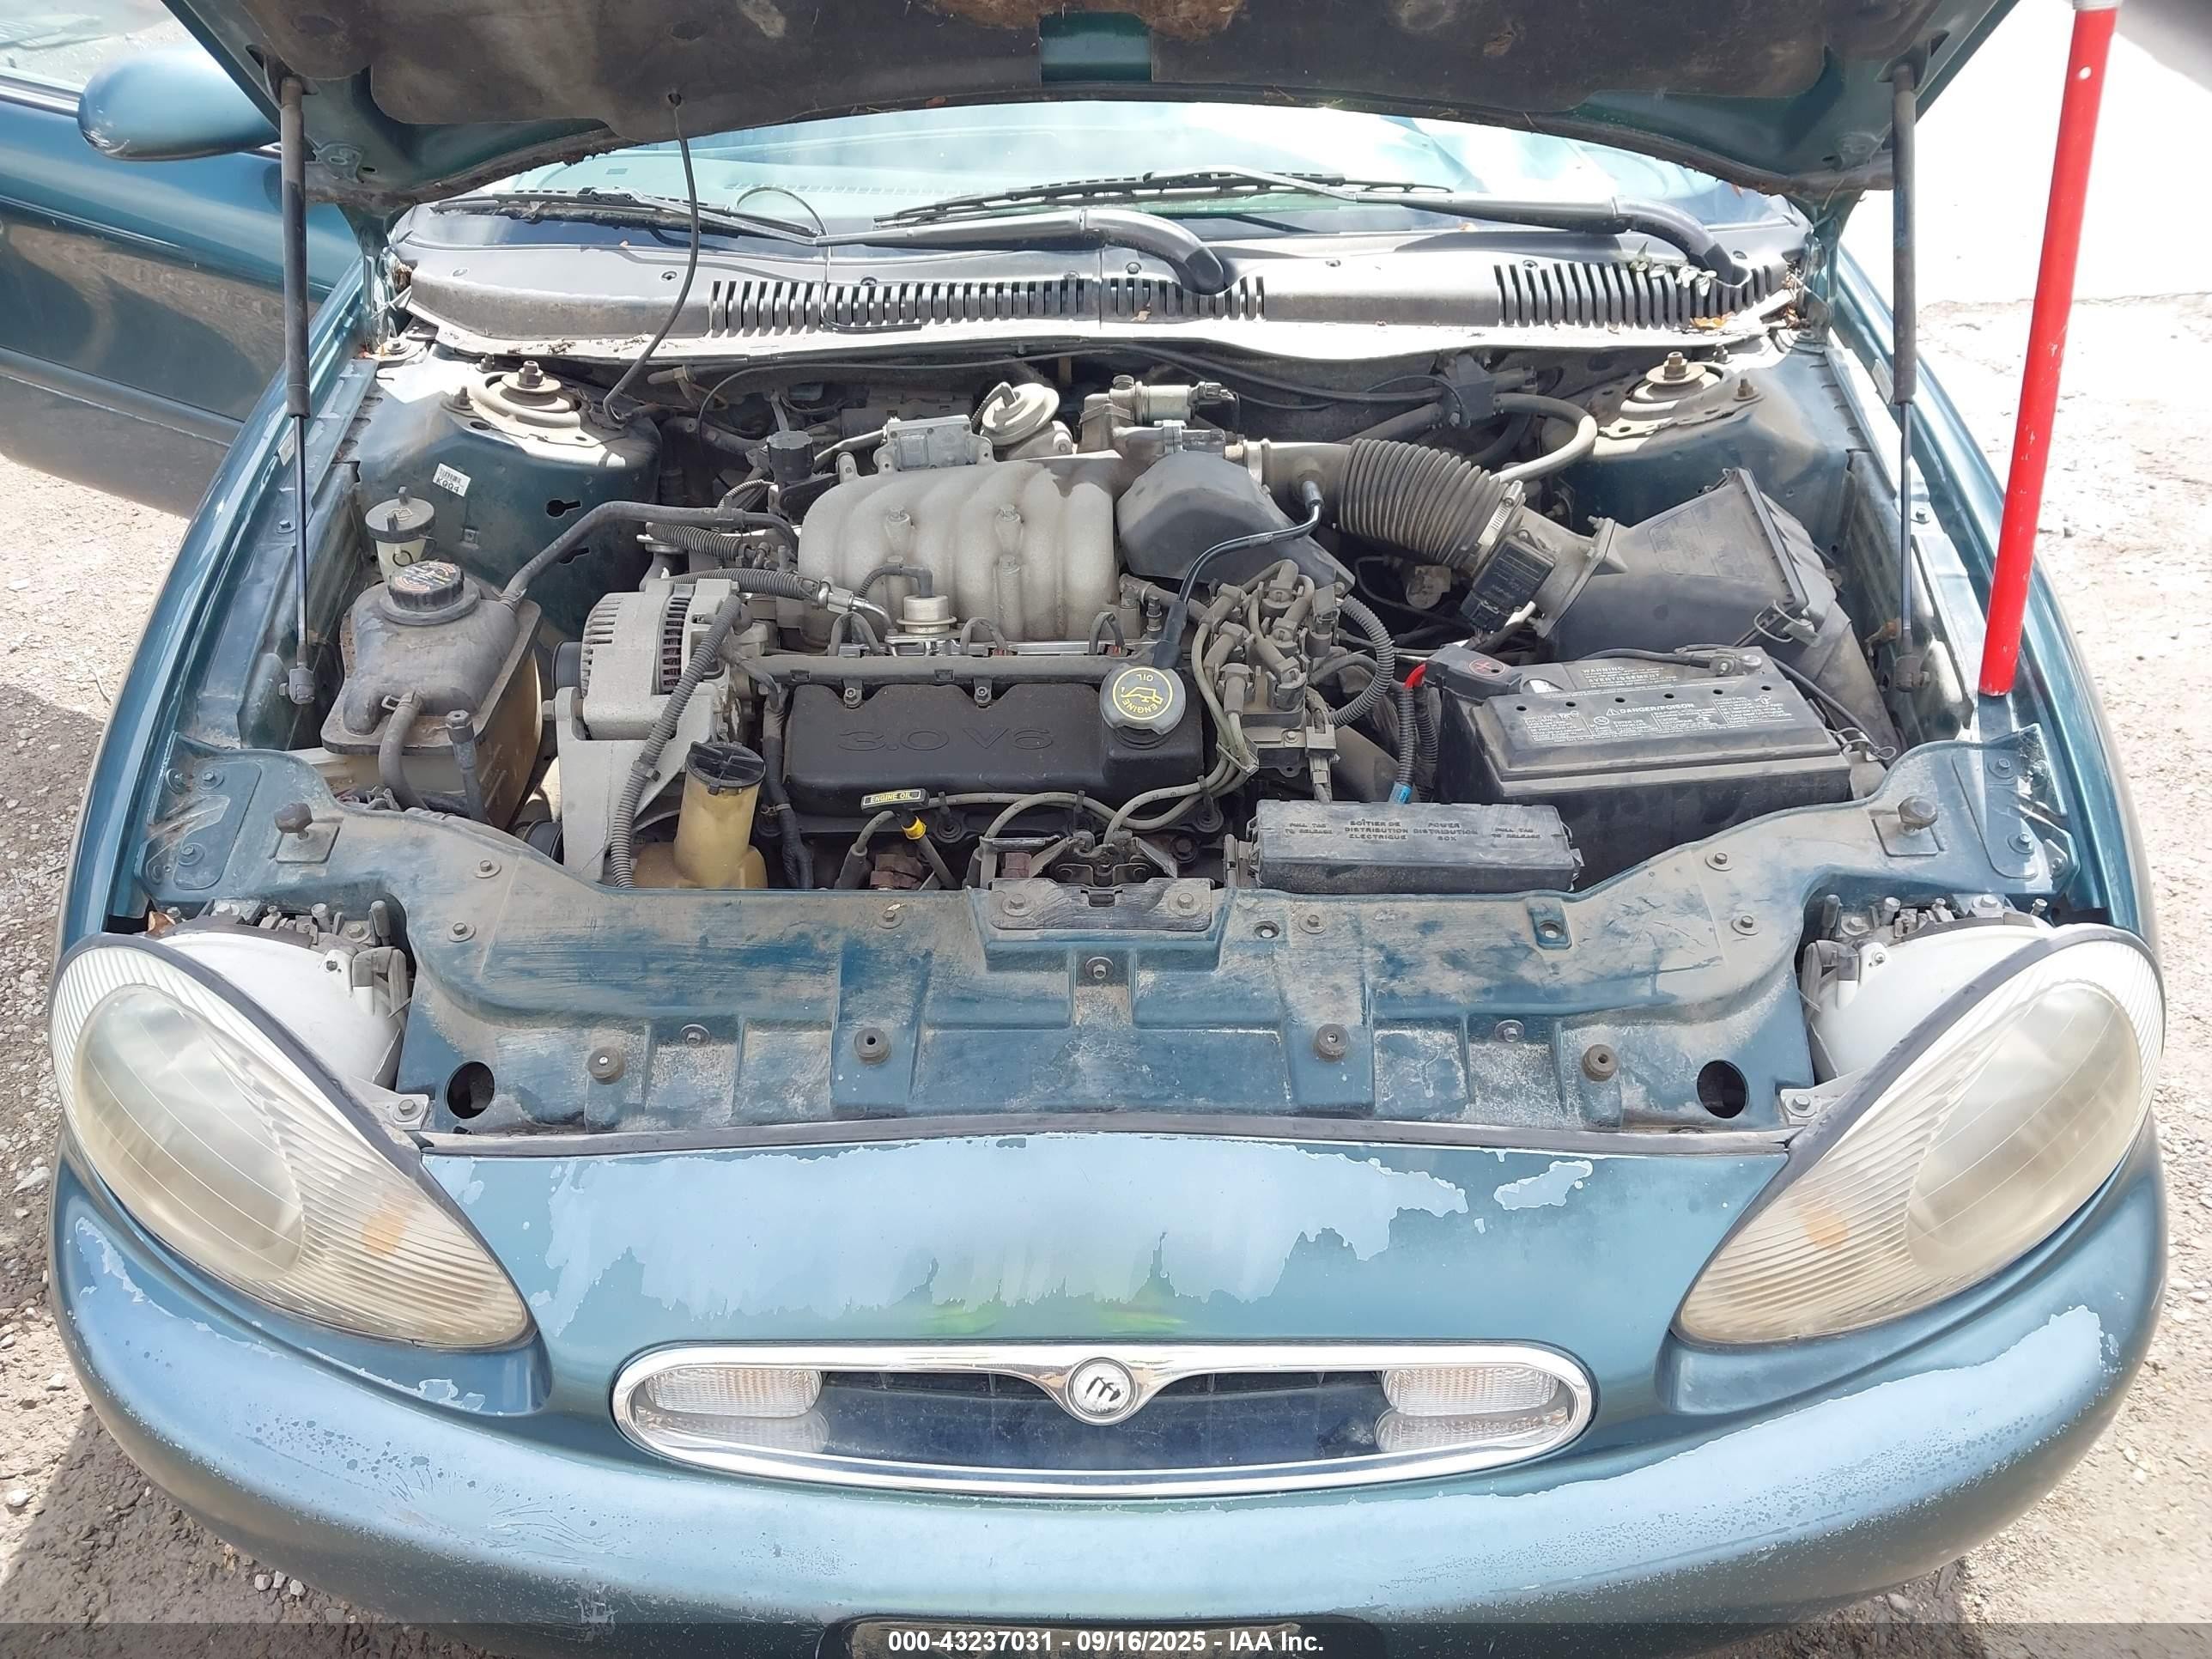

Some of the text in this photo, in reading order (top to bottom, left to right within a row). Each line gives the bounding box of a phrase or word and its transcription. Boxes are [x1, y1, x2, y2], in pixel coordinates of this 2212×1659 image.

[1121, 698, 1158, 714] ENGINE
[1619, 702, 1695, 714] DANGER/POISON
[837, 727, 1054, 751] 3.0 V6
[870, 790, 912, 803] ENGINE OIL
